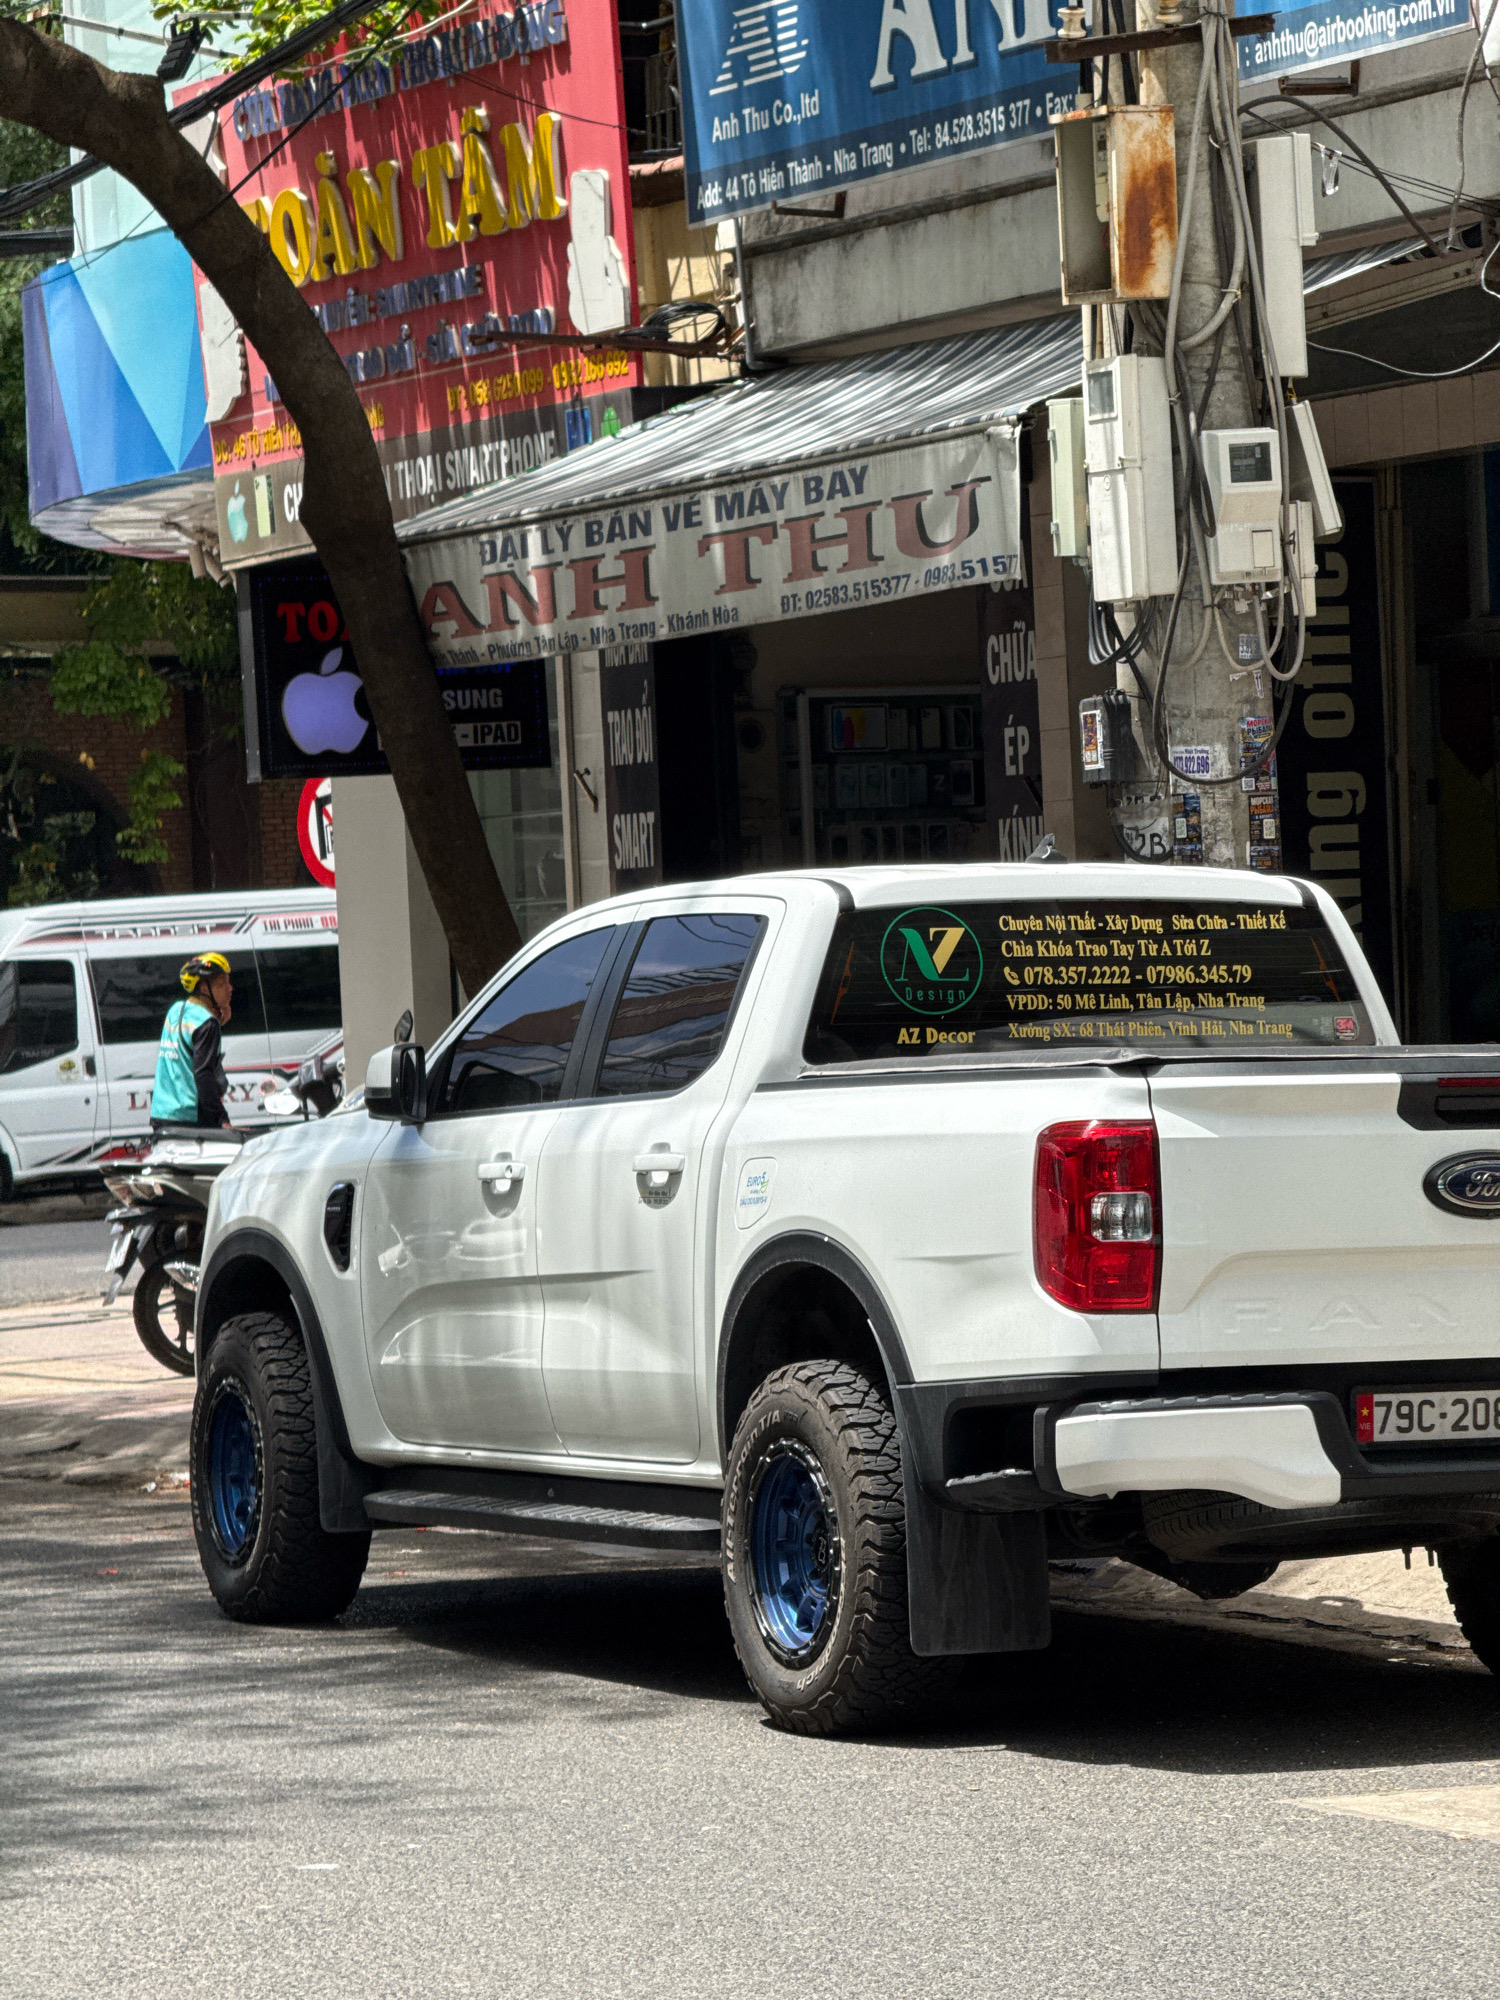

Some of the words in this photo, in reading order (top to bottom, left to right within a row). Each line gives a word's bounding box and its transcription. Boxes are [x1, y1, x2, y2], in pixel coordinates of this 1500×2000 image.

[1255, 0, 1455, 64] anhthu@airbooking.com.vn
[712, 113, 740, 143] Anh
[742, 105, 770, 134] Thu
[773, 89, 820, 127] Co.,ltd
[697, 184, 722, 209] Add:
[725, 179, 739, 202] 44
[741, 170, 757, 198] Tô
[759, 163, 784, 194] Hiến
[787, 155, 823, 188] Thành
[834, 148, 858, 176] Nha
[859, 142, 894, 171] Trang
[909, 129, 932, 155] Tel:
[935, 105, 1006, 148] 84.528.3515
[1009, 99, 1031, 127] 377
[1046, 91, 1074, 116] Fax:
[412, 106, 568, 249] TÂM
[394, 452, 443, 502] THOẠI
[445, 430, 556, 490] SMARTPHONE
[479, 534, 529, 567] ĐẠI
[541, 519, 573, 555] LÝ
[584, 509, 652, 548] BÁN
[714, 480, 790, 523] MÁY
[803, 465, 868, 506] BAY
[420, 544, 659, 643] ANH
[697, 475, 991, 595] THU
[781, 592, 803, 615] ĐT:
[805, 573, 912, 611] 02583.515377
[590, 624, 616, 646] Nha
[618, 618, 656, 643] Trang
[667, 607, 710, 631] Khánh
[712, 602, 739, 626] Hòa
[986, 620, 1038, 685] CHỮA
[442, 687, 504, 711] SUNG
[607, 708, 635, 766] TRAO
[635, 680, 654, 764] ĐỔI
[473, 723, 520, 744] IPAD
[1003, 714, 1030, 776] ÉP
[613, 812, 655, 869] SMART
[998, 805, 1045, 863] KÍNH
[999, 914, 1043, 935] Chuyên
[1046, 915, 1066, 935] Nội
[1068, 911, 1096, 931] Thất
[1106, 914, 1128, 934] Xây
[1131, 914, 1163, 934] Dựng
[1172, 914, 1195, 930] Sửa
[1197, 914, 1228, 930] Chữa
[1237, 910, 1267, 930] Thiết
[1270, 910, 1286, 930] Kế
[1001, 940, 1032, 957] Chìa
[1037, 940, 1073, 957] Khóa
[1076, 940, 1107, 957] Trao
[1110, 940, 1135, 960] Tay
[1139, 939, 1158, 957] Từ
[1160, 940, 1172, 956] A
[1174, 939, 1198, 956] Tới
[1200, 940, 1212, 956] Z
[905, 987, 966, 1004] Design
[1024, 966, 1131, 985] 078.357.2222
[1146, 964, 1252, 985] 07986.345.79
[1056, 994, 1071, 1010] 50
[1075, 994, 1096, 1010] Mê
[1100, 993, 1134, 1012] Linh,
[1136, 993, 1162, 1010] Tân
[1165, 993, 1195, 1012] Lập,
[1197, 993, 1224, 1009] Nha
[1226, 993, 1265, 1011] Trang
[897, 1028, 921, 1044] AZ
[926, 1027, 976, 1044] Decor
[1008, 1023, 1050, 1041] Xưởng
[1053, 1023, 1076, 1038] SX:
[1079, 1022, 1094, 1037] 68
[1096, 1021, 1125, 1037] Thái
[1128, 1021, 1166, 1038] Phiên,
[1169, 1020, 1198, 1036] Vĩnh
[1200, 1020, 1226, 1037] Hải,
[1229, 1020, 1253, 1035] Nha
[1256, 1020, 1293, 1038] Trang
[759, 1410, 781, 1431] T/A
